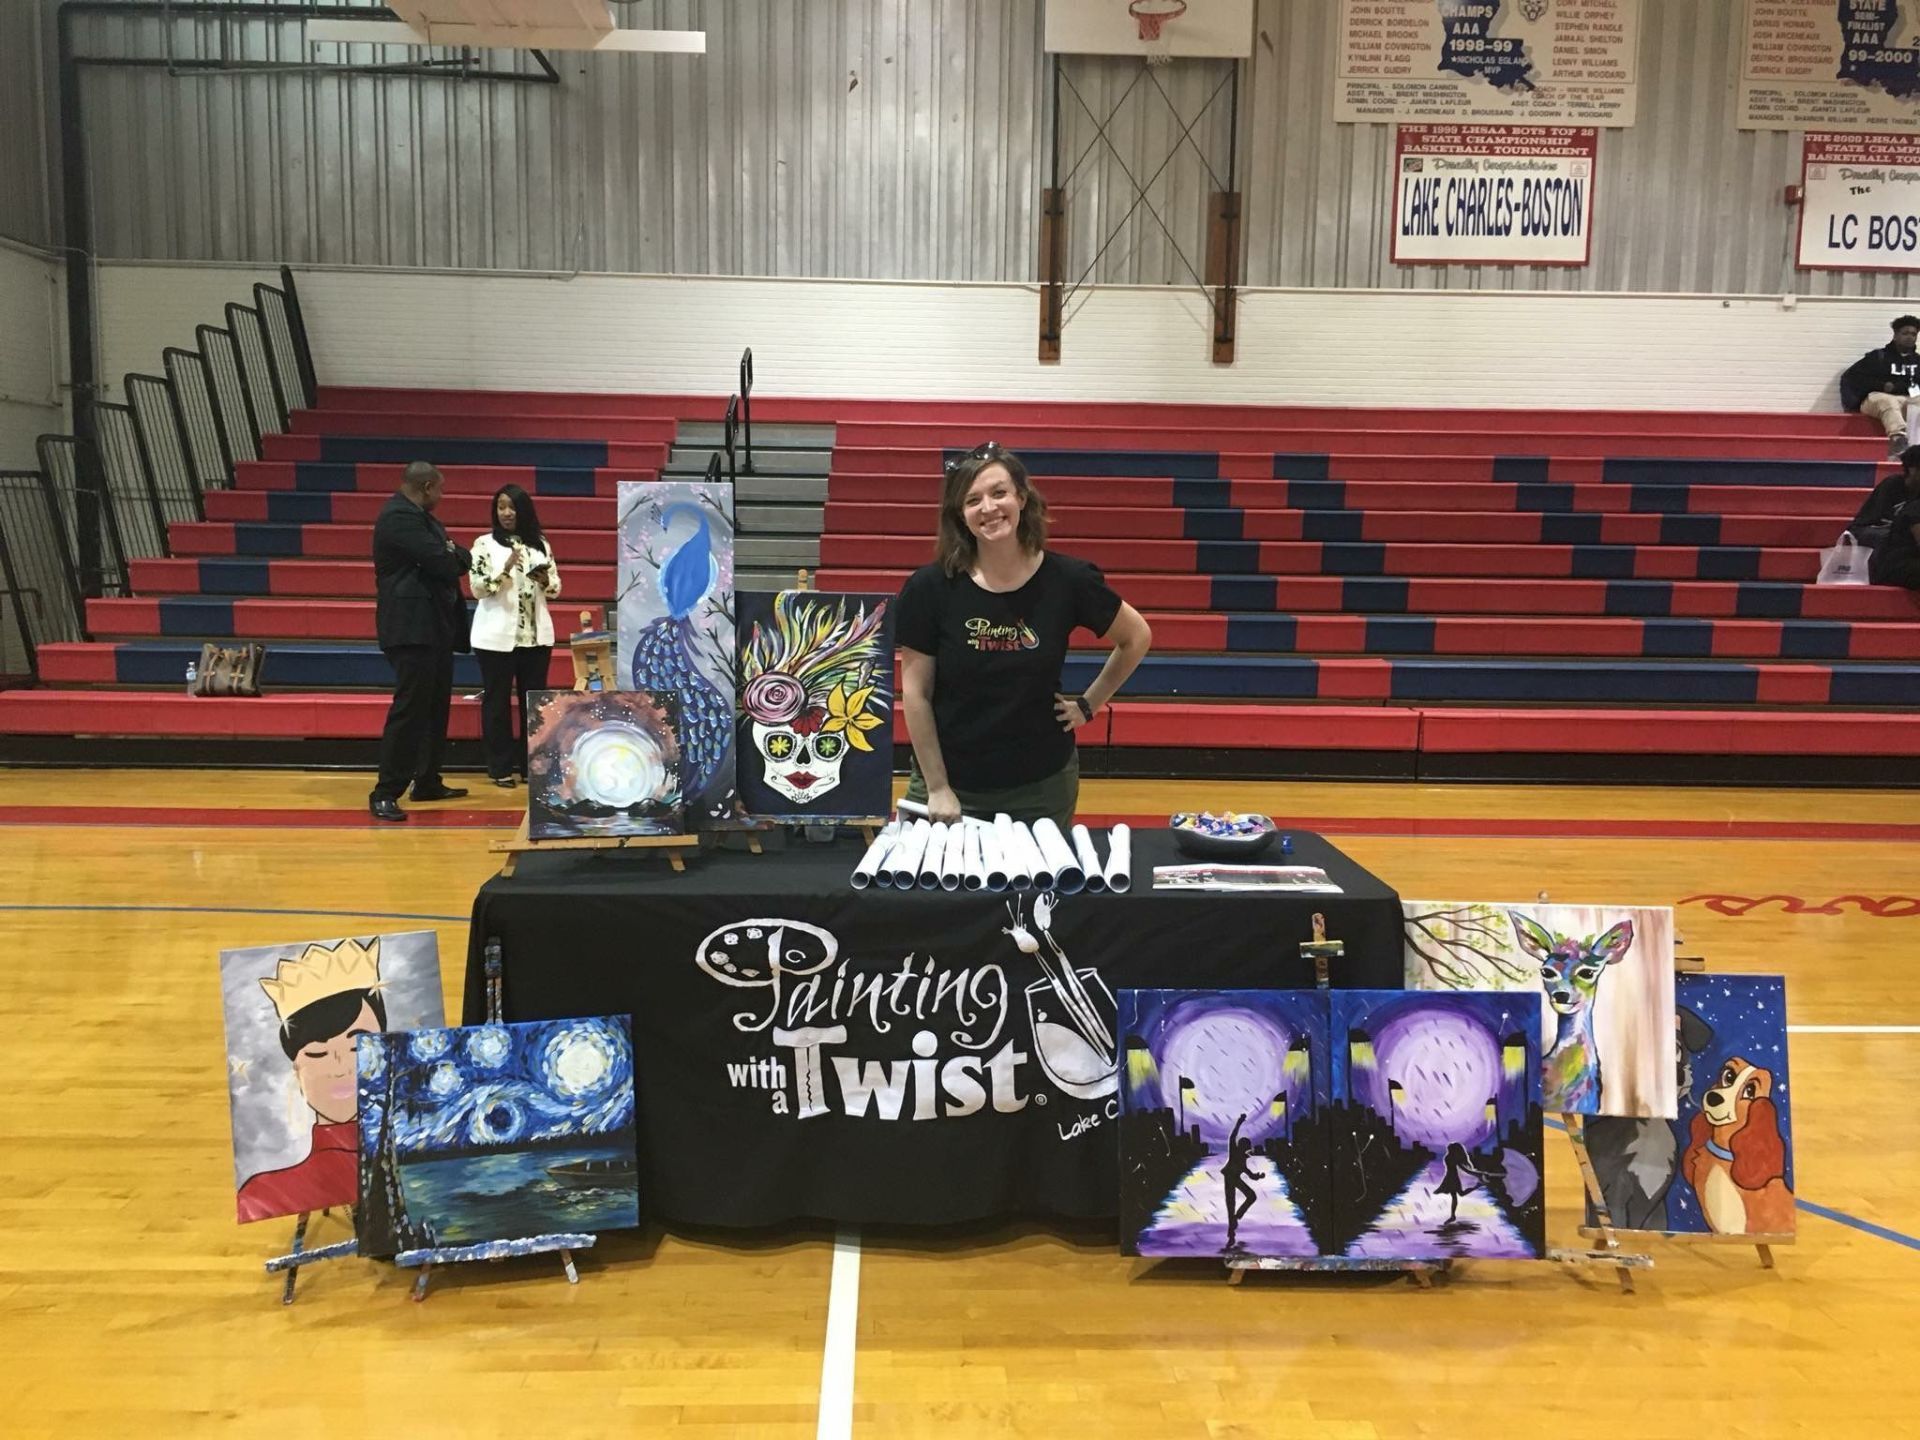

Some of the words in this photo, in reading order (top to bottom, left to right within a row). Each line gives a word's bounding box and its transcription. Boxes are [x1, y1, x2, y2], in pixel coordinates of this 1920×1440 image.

[1452, 22, 1480, 35] AAA
[1847, 21, 1885, 31] FINALIST
[1852, 32, 1879, 44] AAA
[1450, 39, 1513, 52] 1998-99
[1848, 50, 1913, 63] 99-2000
[1401, 125, 1428, 134] THE
[1432, 126, 1458, 135] 1999
[1461, 126, 1507, 136] LHSAA
[1511, 127, 1546, 137] BOYS
[1551, 127, 1577, 137] TOP
[1422, 134, 1461, 144] STATE
[1466, 135, 1572, 146] CHAMPIONSHIP
[1806, 134, 1831, 143] THE
[1864, 136, 1908, 145] LHSAA
[1403, 144, 1490, 154] BASKETBALL
[1494, 146, 1588, 156] TOURNAMENT
[1825, 144, 1865, 153] STATE
[1807, 153, 1891, 163] BASKETBALL
[1850, 186, 1871, 196] The
[1402, 177, 1441, 236] LAKE
[1446, 176, 1584, 238] CHARLES-BOSTON
[1828, 214, 1859, 250] LC
[1868, 215, 1920, 251] BOS
[1891, 363, 1918, 376] LIT
[977, 636, 1020, 651] Twist
[695, 918, 1008, 1050] Painting
[727, 1056, 787, 1089] with
[773, 1024, 1030, 1121] Twist
[772, 1090, 789, 1114] a
[1057, 1113, 1101, 1141] Lake
